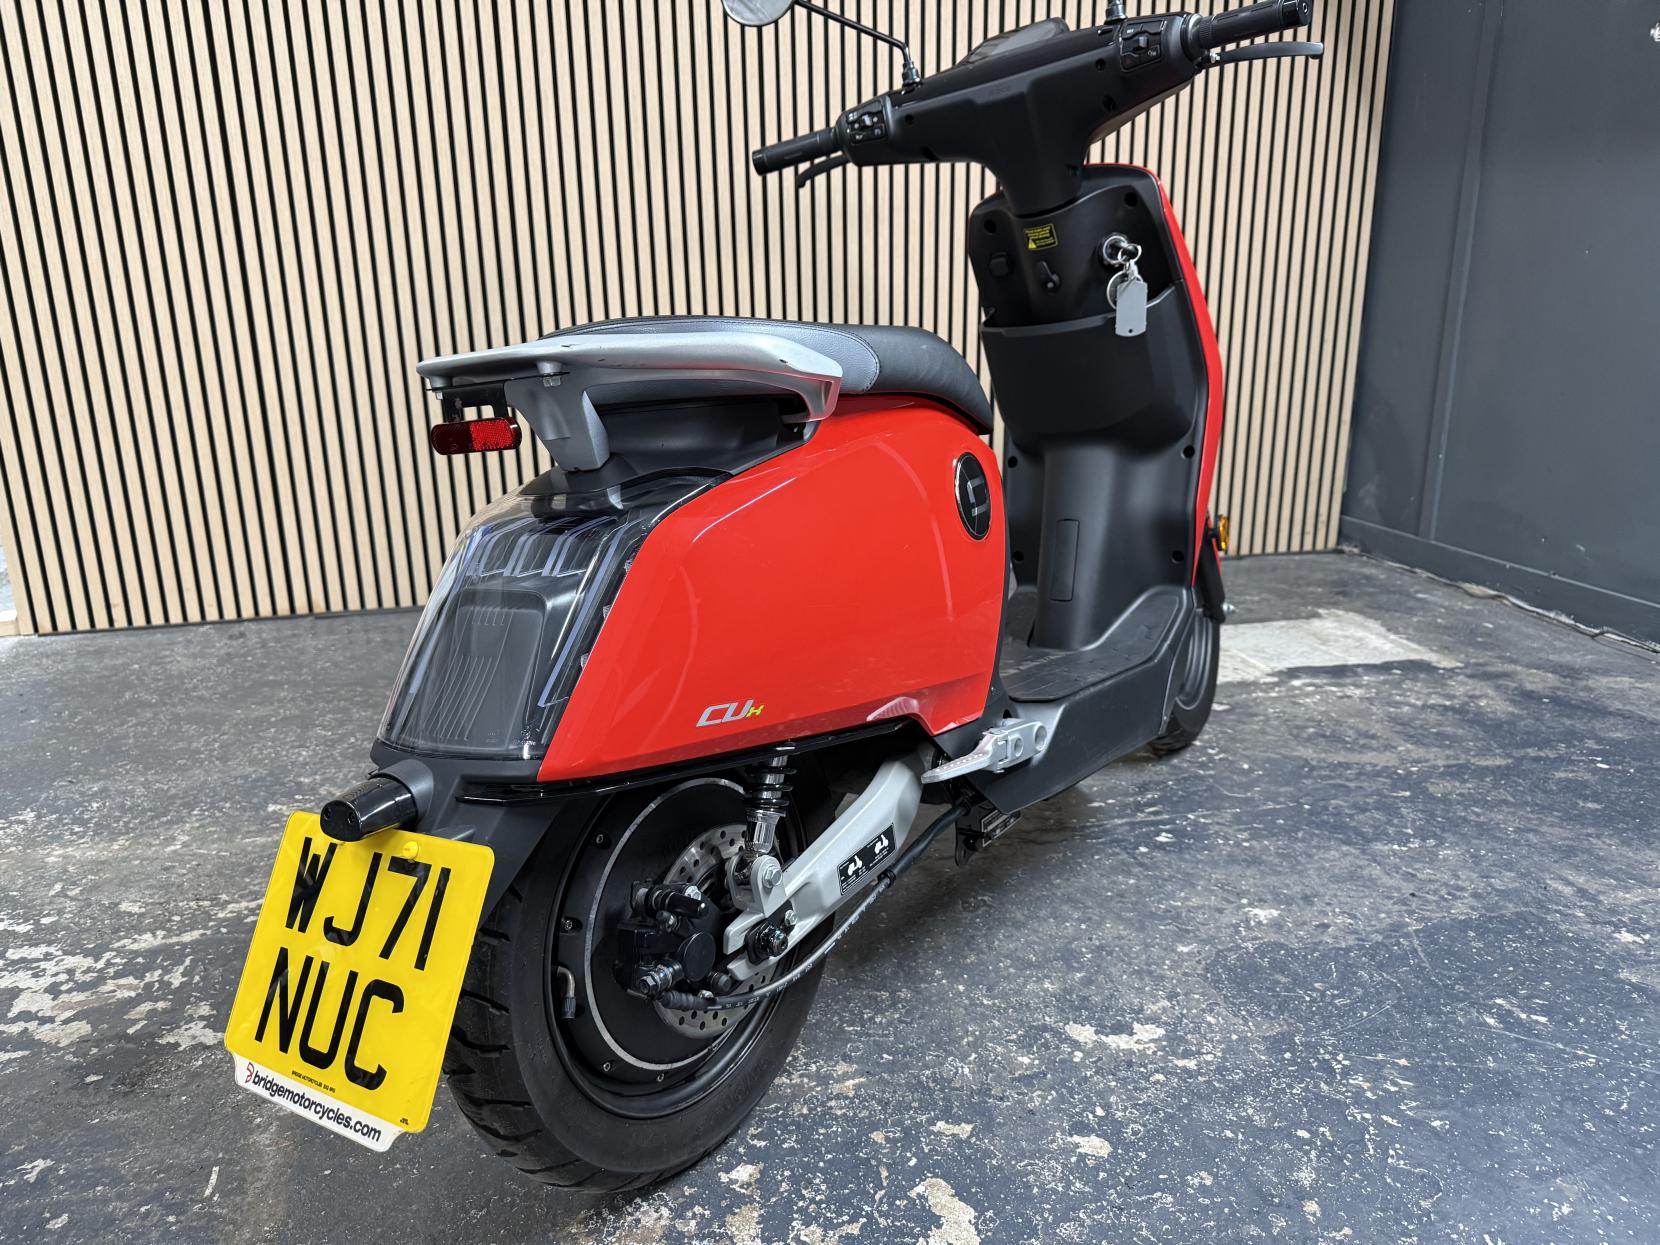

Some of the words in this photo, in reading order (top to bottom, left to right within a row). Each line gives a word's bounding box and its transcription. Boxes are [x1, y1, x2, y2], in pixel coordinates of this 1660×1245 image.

[285, 837, 452, 972] WJ71
[254, 946, 405, 1091] NUC
[252, 1070, 382, 1142] bridgemotorcycles.com
